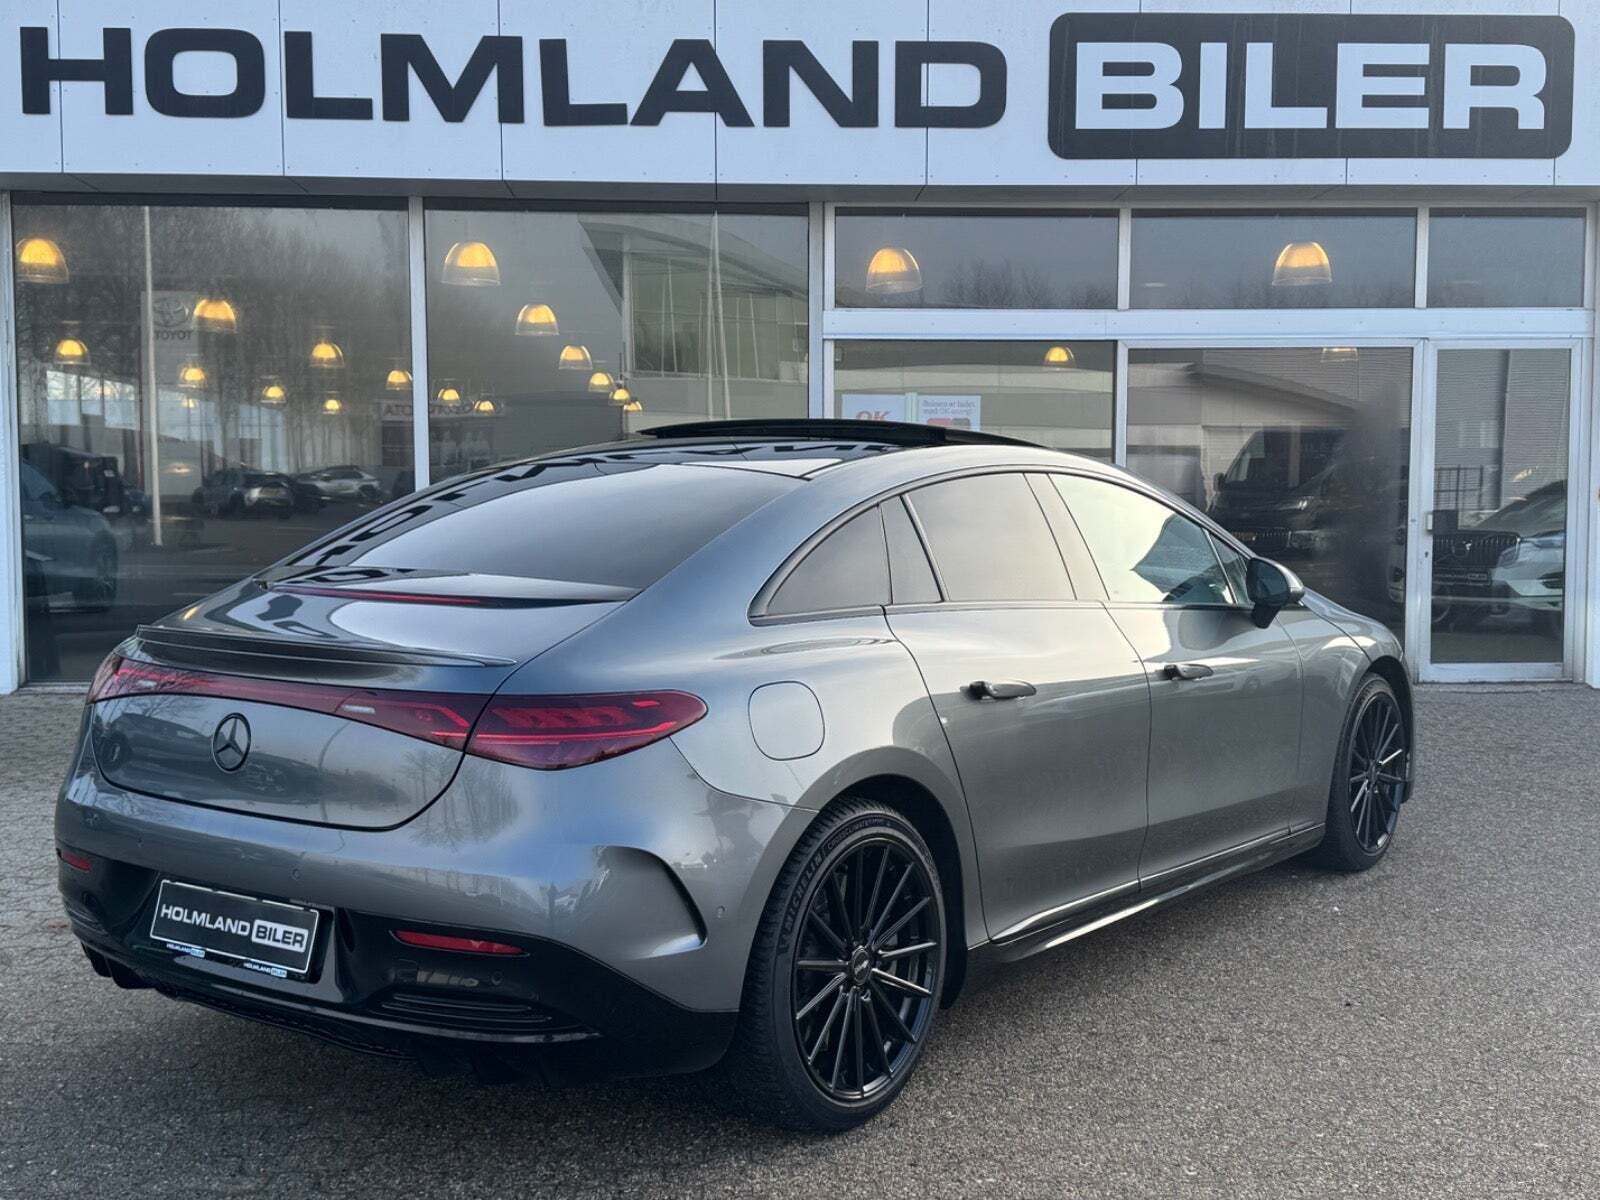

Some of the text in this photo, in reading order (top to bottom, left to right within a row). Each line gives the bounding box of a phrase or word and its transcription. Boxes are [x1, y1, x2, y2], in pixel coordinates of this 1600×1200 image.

[20, 26, 1547, 130] HOLMLAND BILER
[160, 903, 306, 949] HOLMLAND BILER
